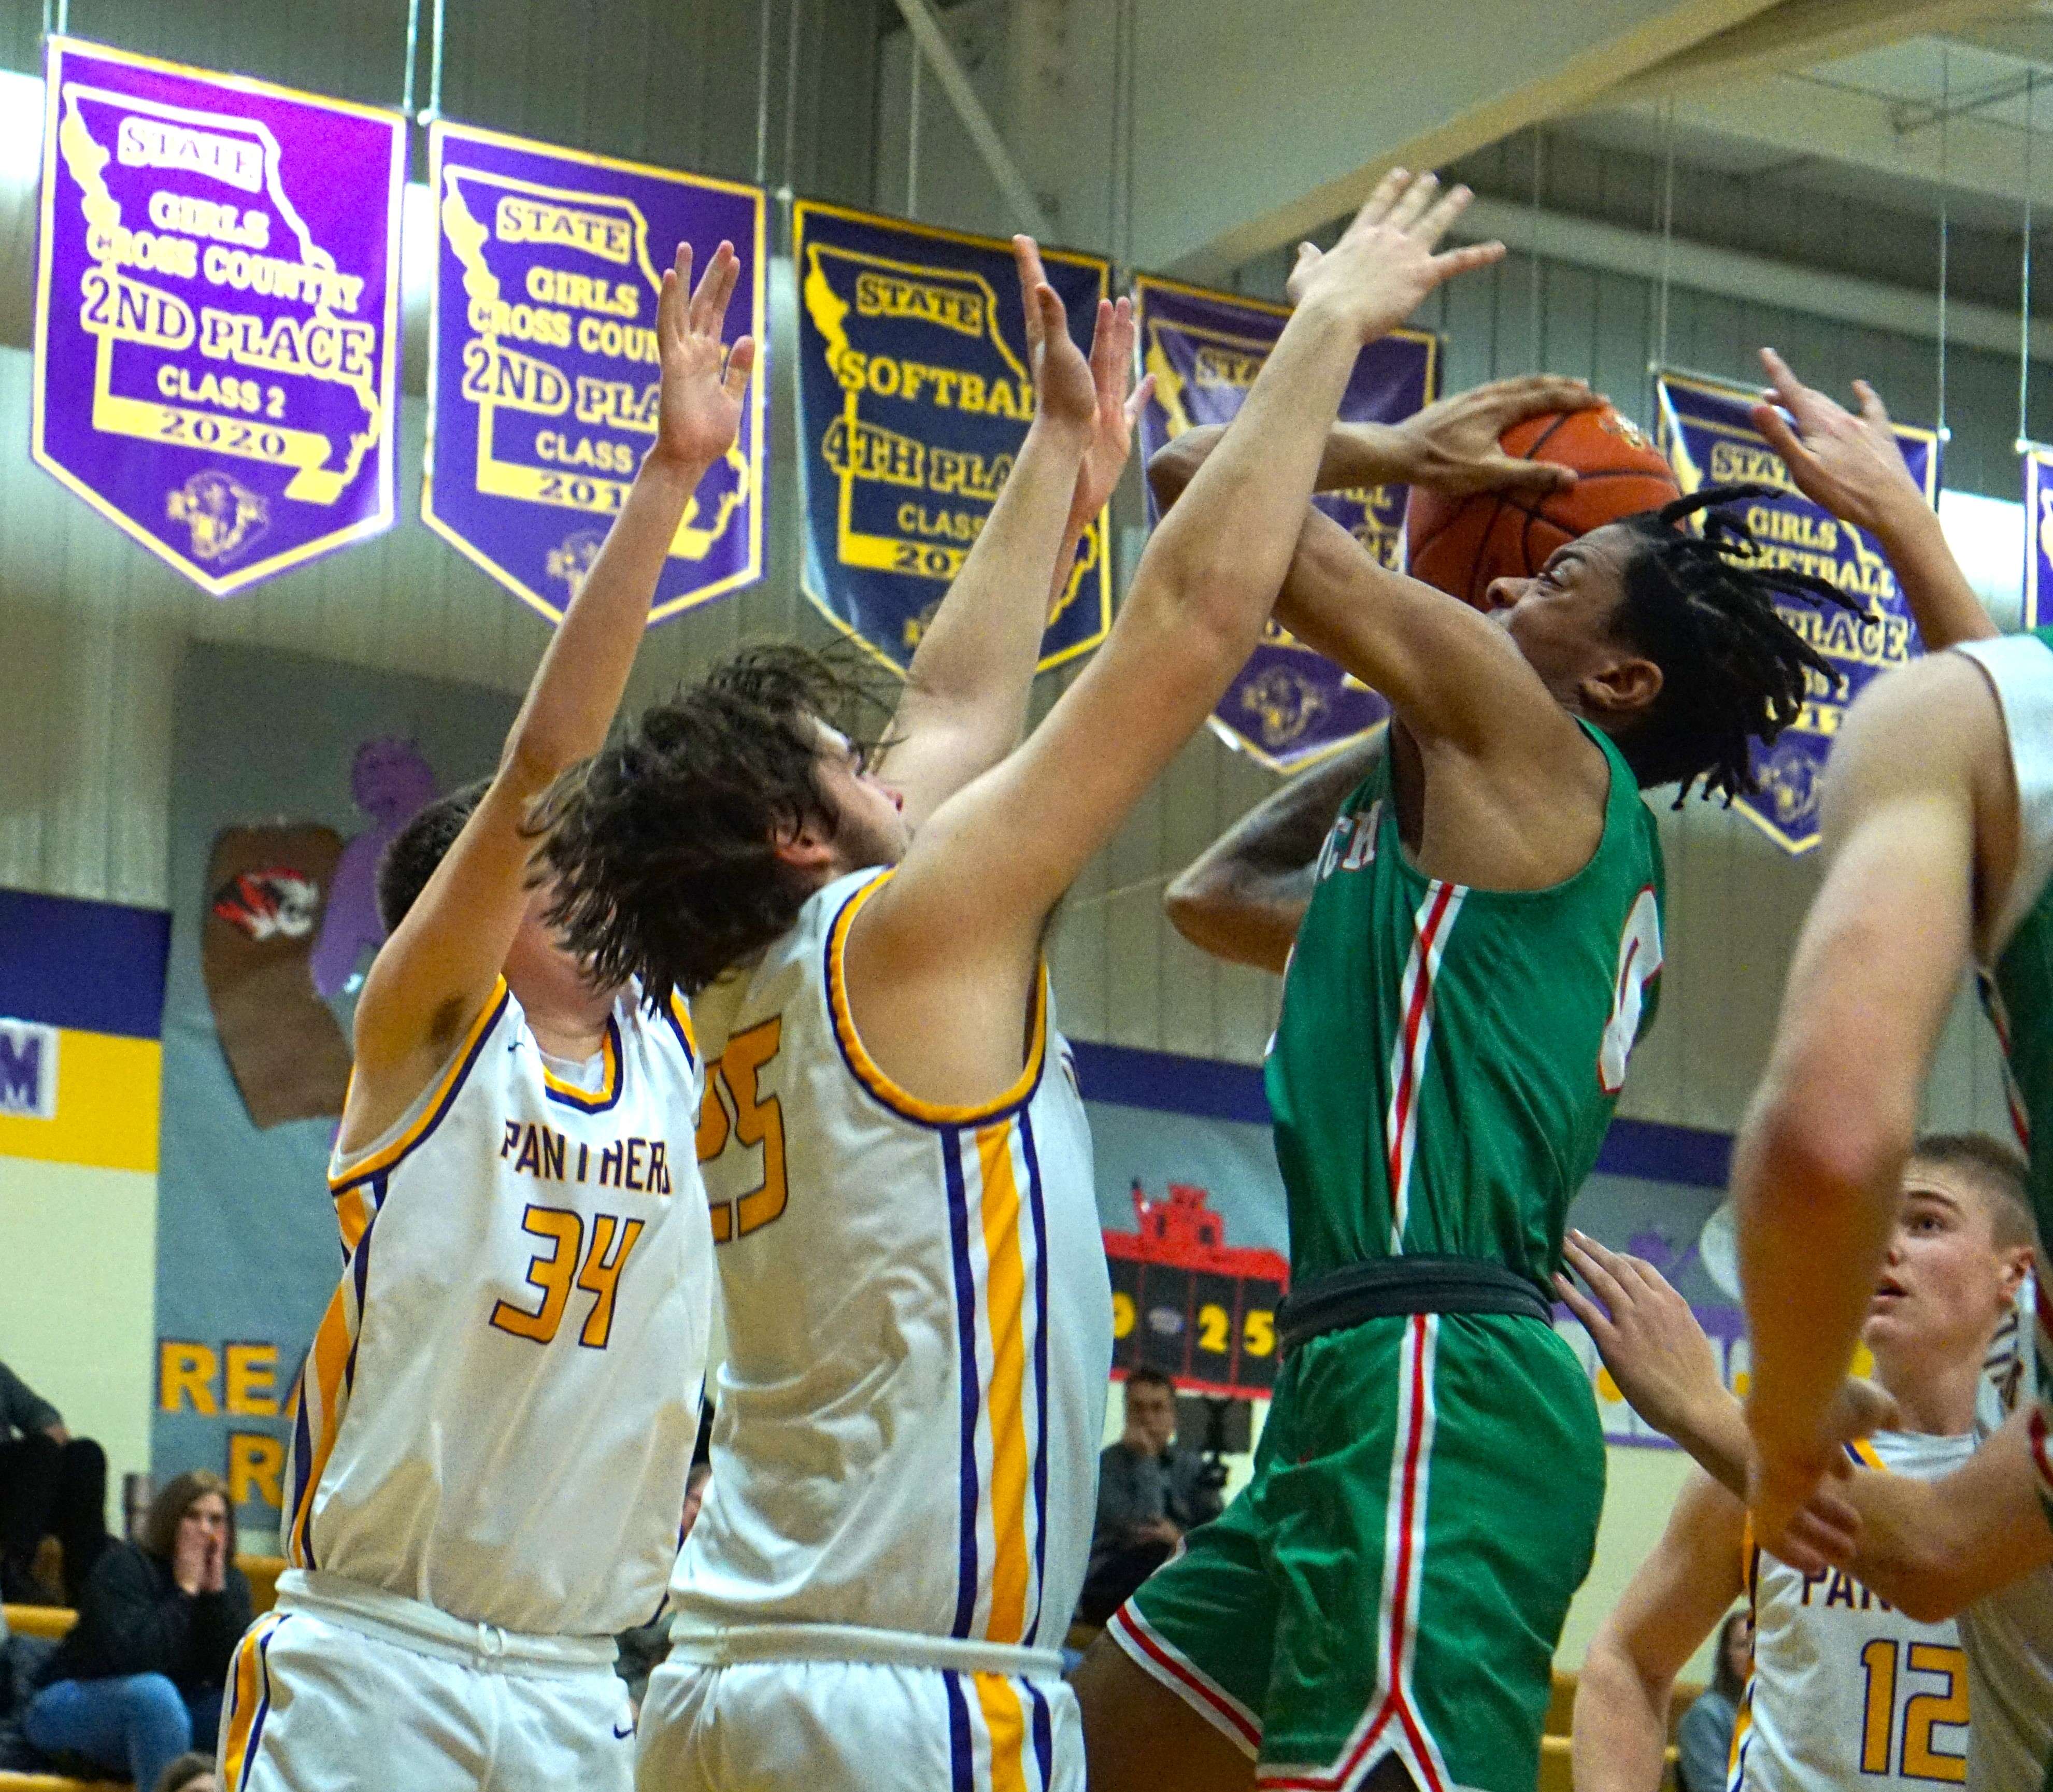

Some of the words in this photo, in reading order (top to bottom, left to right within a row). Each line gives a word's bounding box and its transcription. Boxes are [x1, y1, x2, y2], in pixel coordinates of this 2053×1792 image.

[125, 124, 256, 181] STATE
[149, 191, 269, 249] GIRLS
[503, 204, 626, 254] STATE
[87, 223, 198, 278] CROSS
[204, 245, 363, 312] COUNTRY
[526, 265, 639, 319] GIRLS
[87, 275, 188, 339] 2ND
[208, 316, 366, 376] PLACE
[468, 297, 572, 348] CROSS
[578, 317, 662, 364] COUN
[861, 276, 979, 328] STATE
[158, 365, 261, 413] CLASS
[267, 386, 285, 418] 2
[468, 346, 564, 406] 2ND
[583, 382, 661, 423] PLA
[838, 350, 1035, 422] SOFTBAL
[161, 413, 286, 456] 2020
[535, 431, 633, 473] CLASS
[829, 422, 918, 481] 4TH
[935, 454, 1013, 492] PLA
[539, 471, 622, 509] 201
[1747, 506, 1838, 551] GIRLS
[489, 1203, 645, 1350] 34
[1199, 1304, 1277, 1357] 25
[1860, 1639, 1969, 1783] 12
